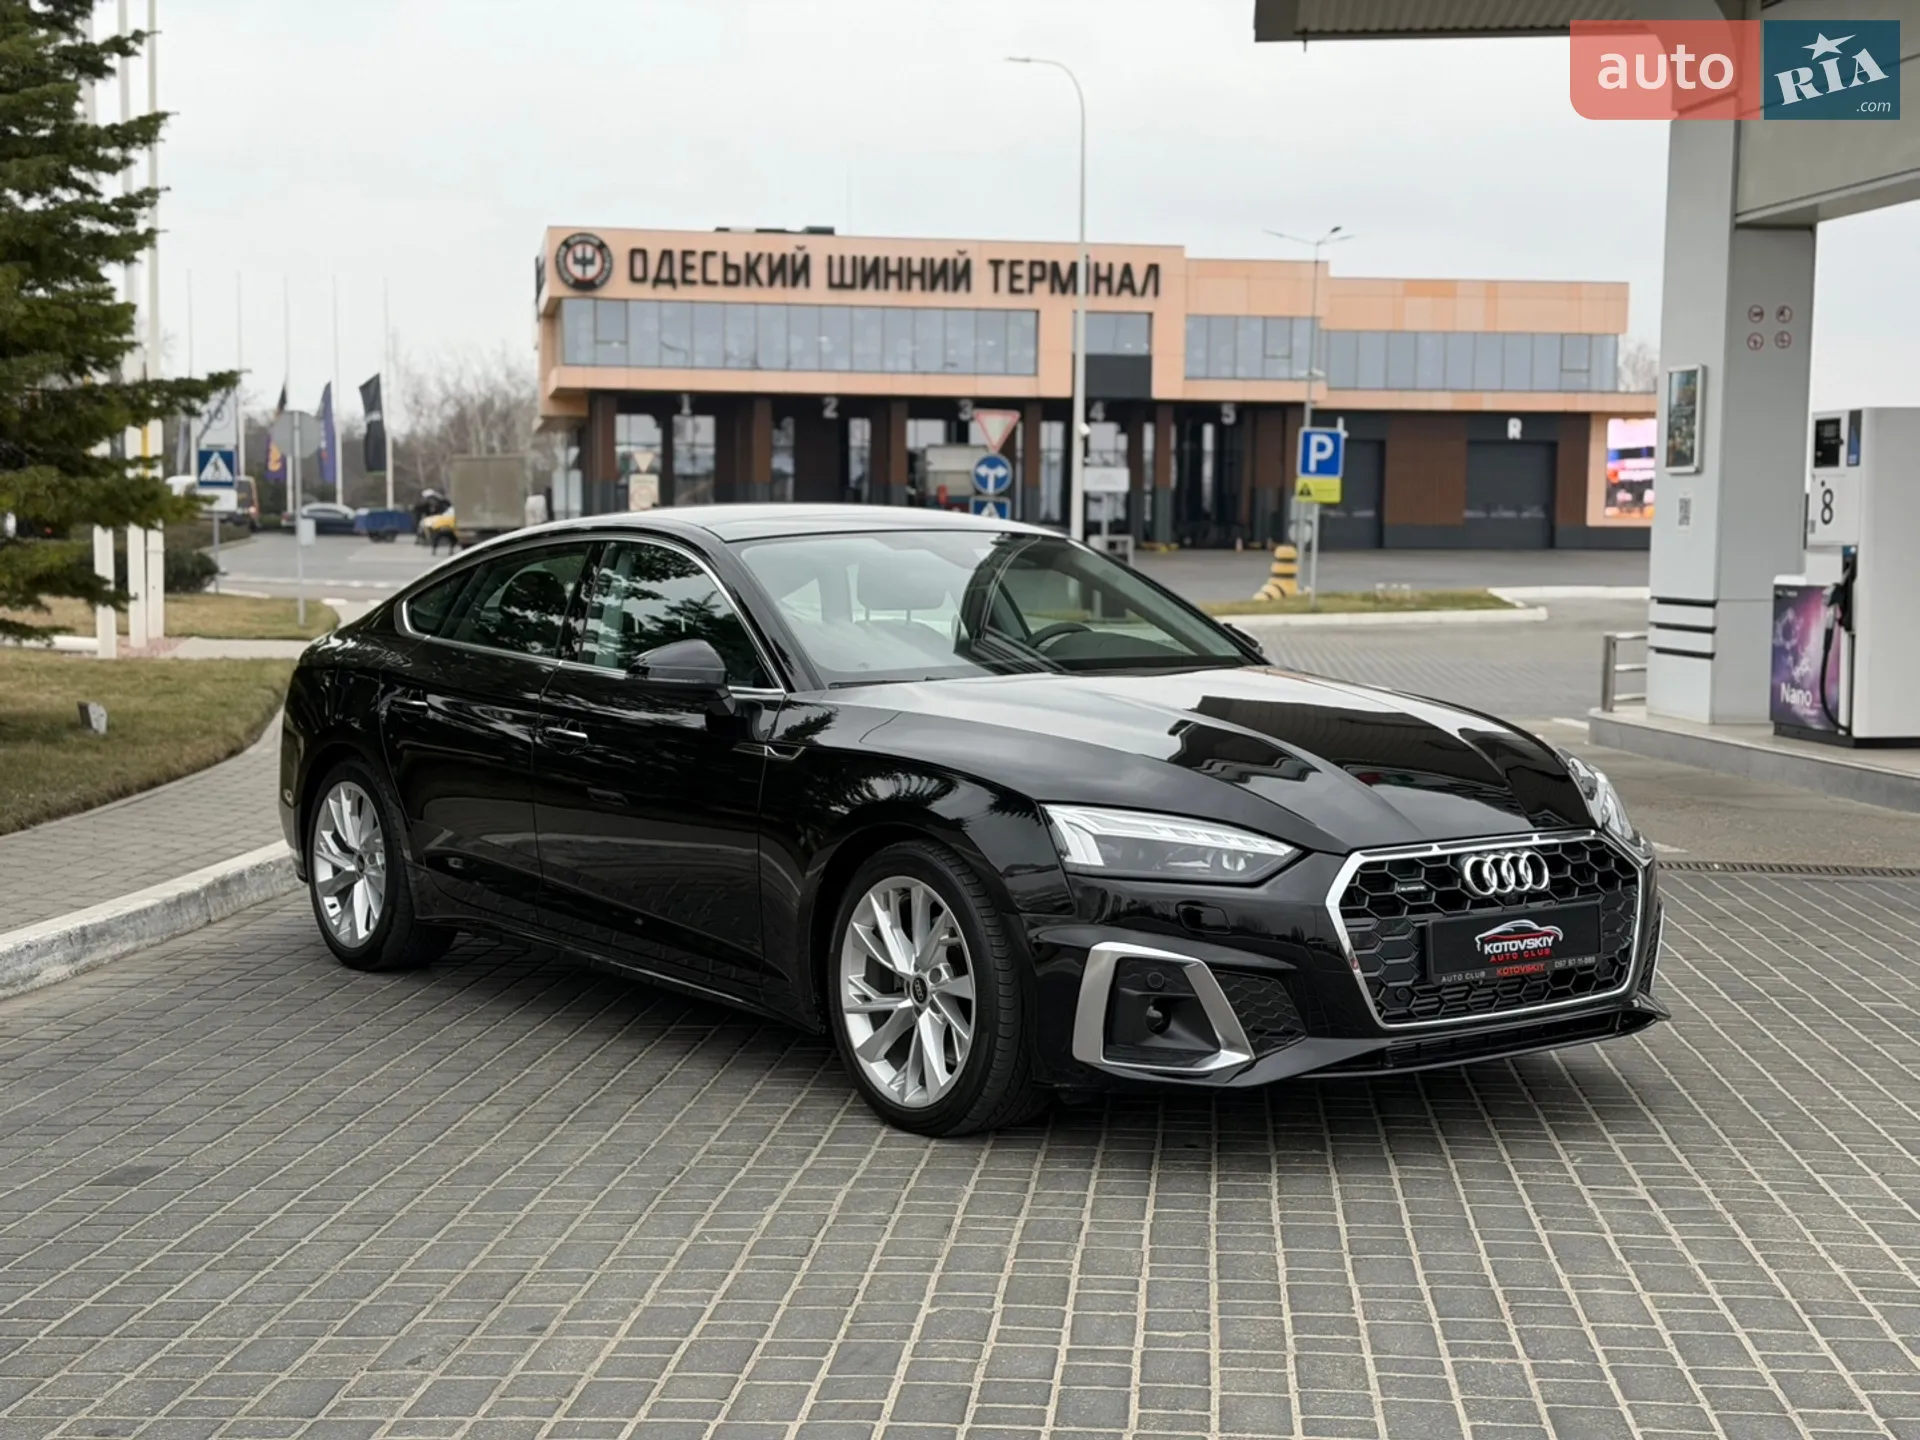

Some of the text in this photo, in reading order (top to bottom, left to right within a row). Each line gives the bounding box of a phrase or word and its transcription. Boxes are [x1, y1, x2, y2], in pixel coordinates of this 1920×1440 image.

[629, 244, 811, 291] ОДЕСЬКИЙ
[827, 249, 971, 293] ШИННИЙ
[988, 254, 1160, 298] ТЕРМІНАЛ
[680, 394, 692, 415] 1
[823, 397, 838, 419] 2
[959, 399, 973, 421] 3
[1089, 401, 1105, 422] 4
[1221, 403, 1236, 425] 5
[1507, 417, 1522, 439] R
[1308, 434, 1335, 473] P
[1821, 488, 1833, 525] 8
[1780, 682, 1812, 707] Nano
[1484, 936, 1555, 955] KOTOVSKIY
[1490, 949, 1551, 963] AUTO CLUB
[1441, 973, 1463, 984] AUTO
[1465, 970, 1486, 981] CLUB
[1496, 963, 1545, 977] KOTOVSKIY
